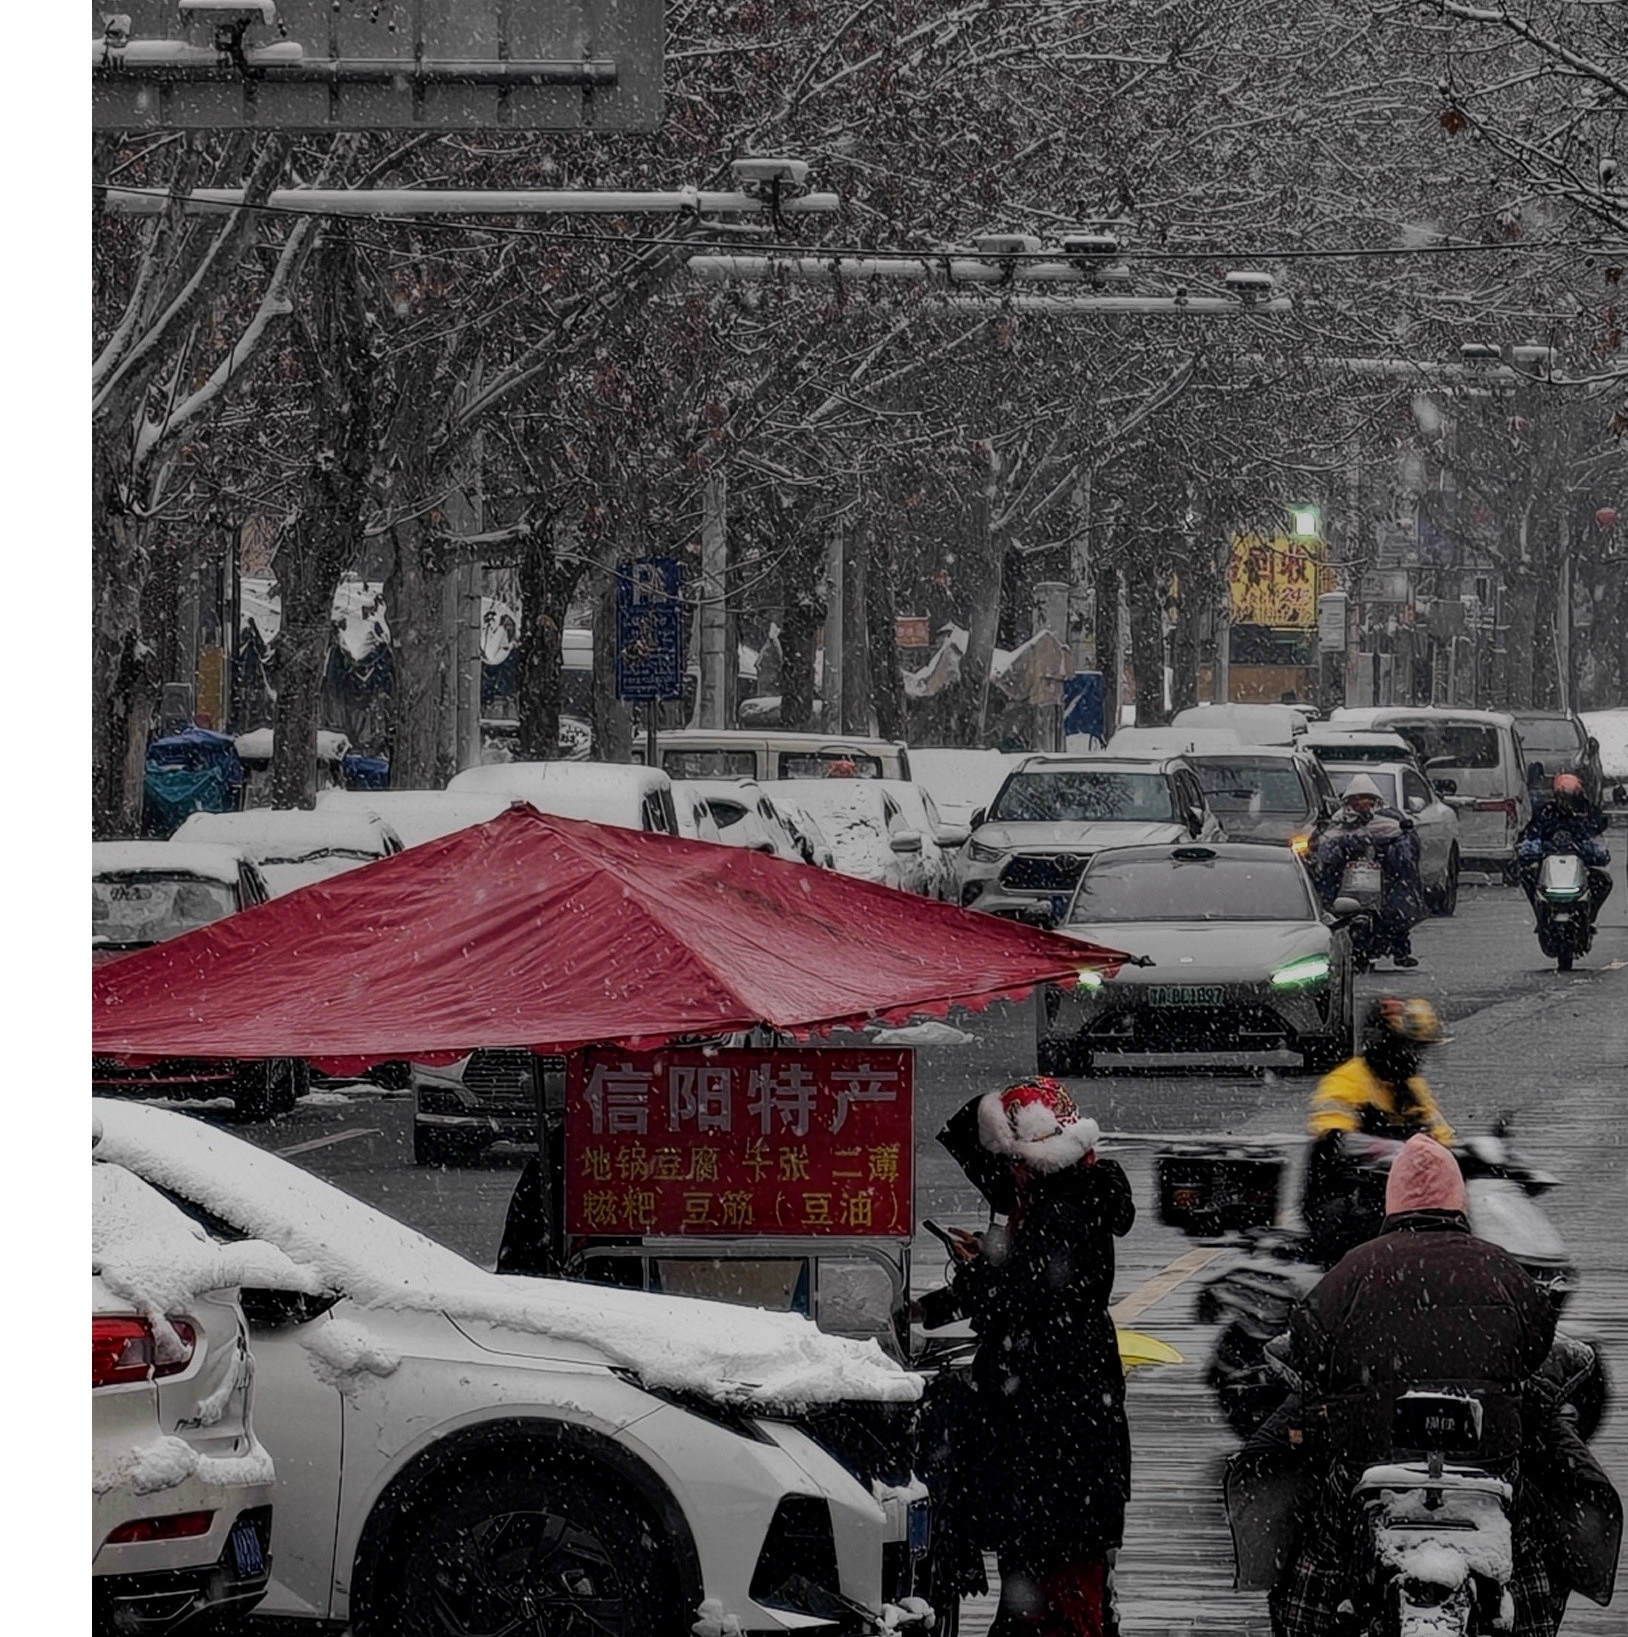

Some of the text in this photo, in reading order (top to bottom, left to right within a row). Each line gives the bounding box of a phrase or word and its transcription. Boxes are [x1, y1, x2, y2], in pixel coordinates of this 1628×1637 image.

[583, 1062, 900, 1136] 信阳特产
[581, 1144, 721, 1182] 地锅豆腐
[741, 1141, 811, 1183] 千张
[582, 1190, 659, 1227] 糍粑
